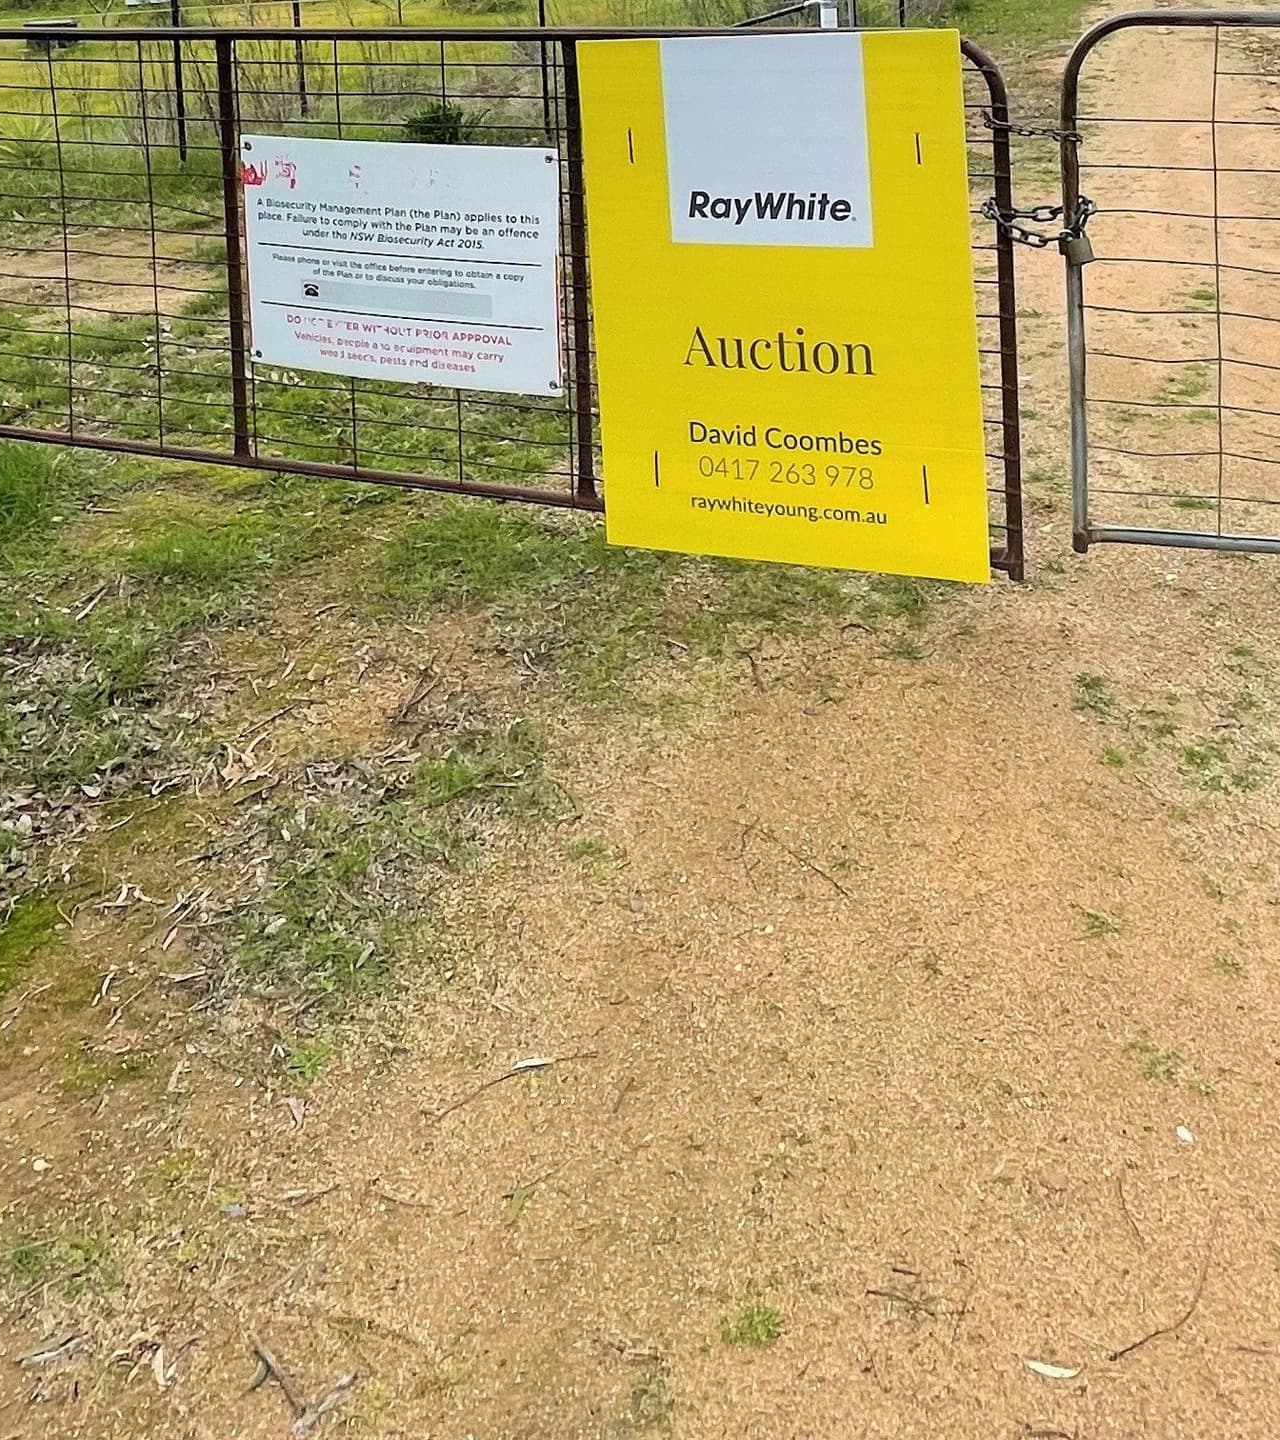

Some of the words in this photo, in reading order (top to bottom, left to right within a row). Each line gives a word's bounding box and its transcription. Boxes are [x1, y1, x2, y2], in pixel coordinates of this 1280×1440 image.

[257, 198, 264, 206] A
[266, 198, 317, 213] Biosecurity
[319, 203, 382, 217] Management
[385, 207, 406, 218] Plan
[409, 208, 430, 219] (the
[434, 209, 461, 221] Plan)
[464, 211, 502, 223] applies
[506, 214, 517, 223] to
[520, 214, 540, 225] this
[286, 213, 318, 224] Failure
[320, 216, 330, 225] to
[332, 217, 368, 229] comply
[371, 221, 392, 230] with
[395, 221, 412, 231] the
[415, 223, 437, 232] Plan
[440, 225, 462, 236] may
[465, 225, 479, 235] be
[482, 228, 495, 236] an
[498, 227, 539, 239] offence
[303, 228, 329, 239] under
[332, 230, 348, 240] the
[350, 231, 376, 242] NSW
[377, 233, 434, 248] Biosecurity
[437, 238, 454, 248] Act
[454, 269, 464, 277] to
[466, 270, 494, 280] obtain
[503, 274, 525, 283] copy
[287, 314, 301, 324] DO
[415, 328, 449, 341] PRIOR
[452, 331, 513, 347] APPROVAL
[452, 348, 474, 360] may
[477, 351, 504, 363] carry
[683, 326, 877, 377] Auction
[689, 421, 756, 448] David
[764, 427, 883, 456] Coombes
[698, 455, 760, 482] 0417
[769, 460, 816, 487] 263
[825, 464, 875, 490] 978
[690, 493, 888, 526] raywhiteyoung.com.au
